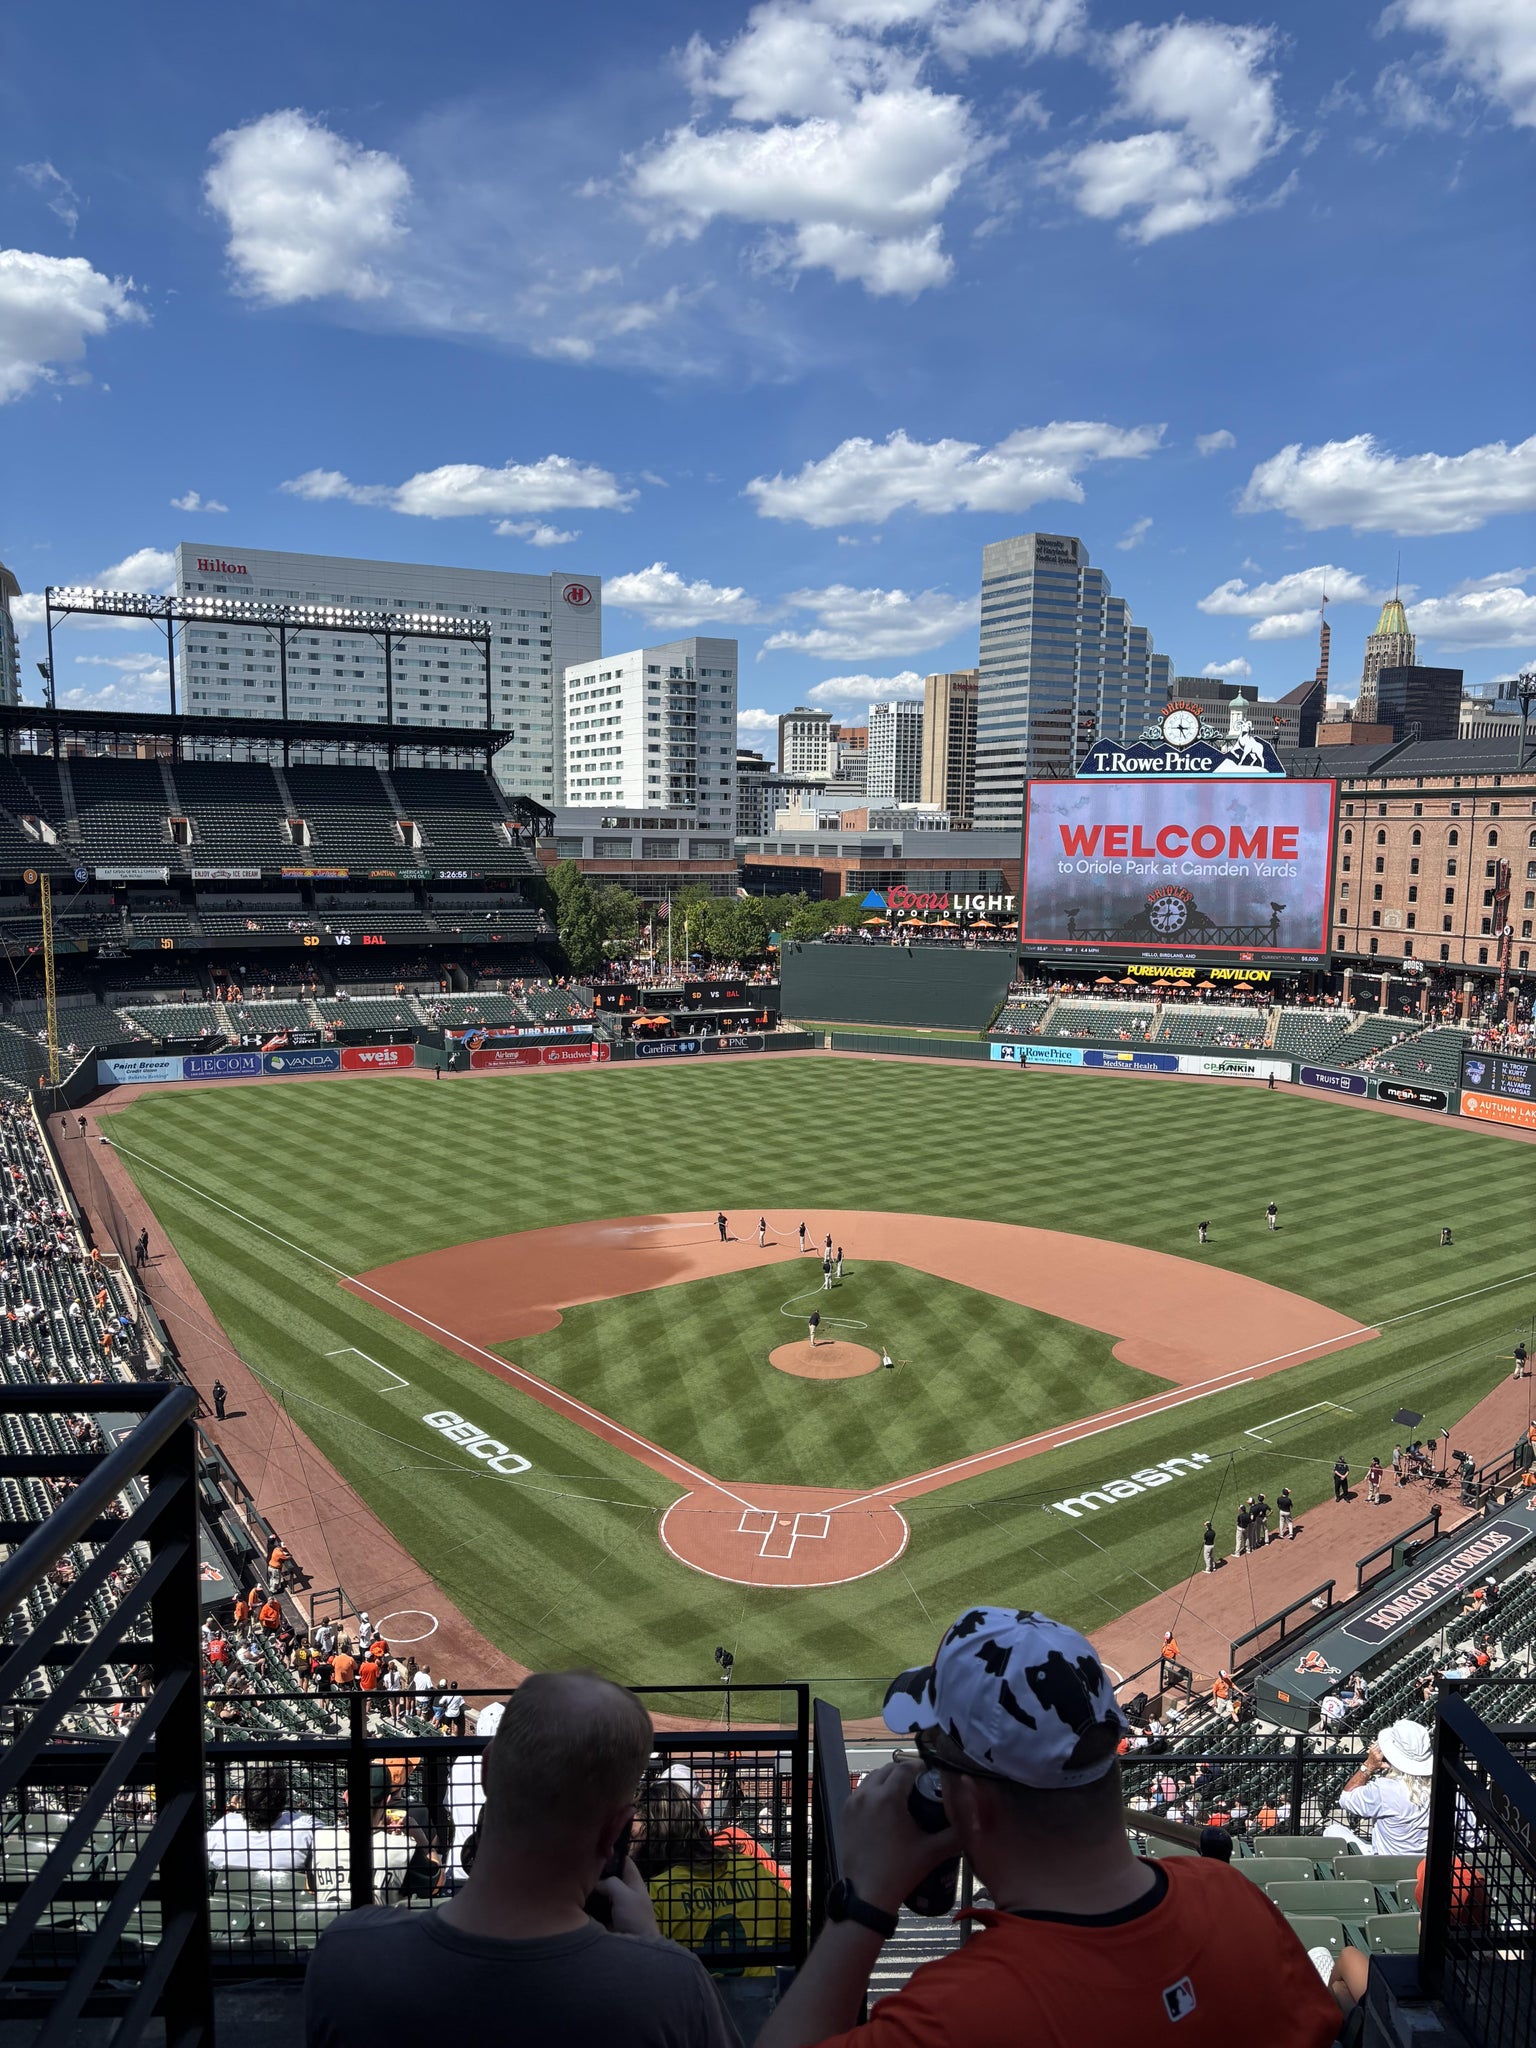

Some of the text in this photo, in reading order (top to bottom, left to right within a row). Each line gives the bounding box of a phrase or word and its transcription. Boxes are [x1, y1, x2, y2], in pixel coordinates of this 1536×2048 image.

[197, 558, 248, 575] Hilton
[1160, 699, 1204, 717] ORIOLES
[1059, 824, 1299, 860] WELCOME
[194, 870, 210, 878] ENJOY
[232, 870, 241, 878] ICE
[242, 870, 259, 878] CREAM
[440, 870, 468, 878] 3:26:55
[1057, 860, 1298, 877] to Oriole Park at Camden Yards
[887, 885, 1016, 912] Coors LIGHT
[1147, 884, 1193, 903] ORIOLES
[886, 909, 986, 919] ROOF DECK
[303, 935, 386, 946] SD VS BAL
[1127, 964, 1271, 981] PUREWAGER PAVILION
[518, 1027, 541, 1036] BIRD
[543, 1026, 567, 1034] BATH
[729, 1038, 748, 1046] PNC
[642, 1043, 678, 1054] CareFirst
[285, 1056, 333, 1066] VANDA
[358, 1050, 398, 1063] weis
[191, 1058, 254, 1072] LECOM
[1103, 1060, 1158, 1070] MedStar Health
[1510, 1063, 1529, 1071] TROUT
[1315, 1073, 1340, 1085] TRUIST
[1506, 1081, 1532, 1090] ALVAREZ
[1508, 1087, 1531, 1096] VARGAS
[1480, 1101, 1517, 1114] AUTUMN
[422, 1410, 533, 1475] GEICO
[1051, 1452, 1212, 1518] masn+
[1365, 1530, 1512, 1631] HOME OF THE ORIOLES
[1328, 1703, 1334, 1712] 2
[1502, 1794, 1532, 1848] 334
